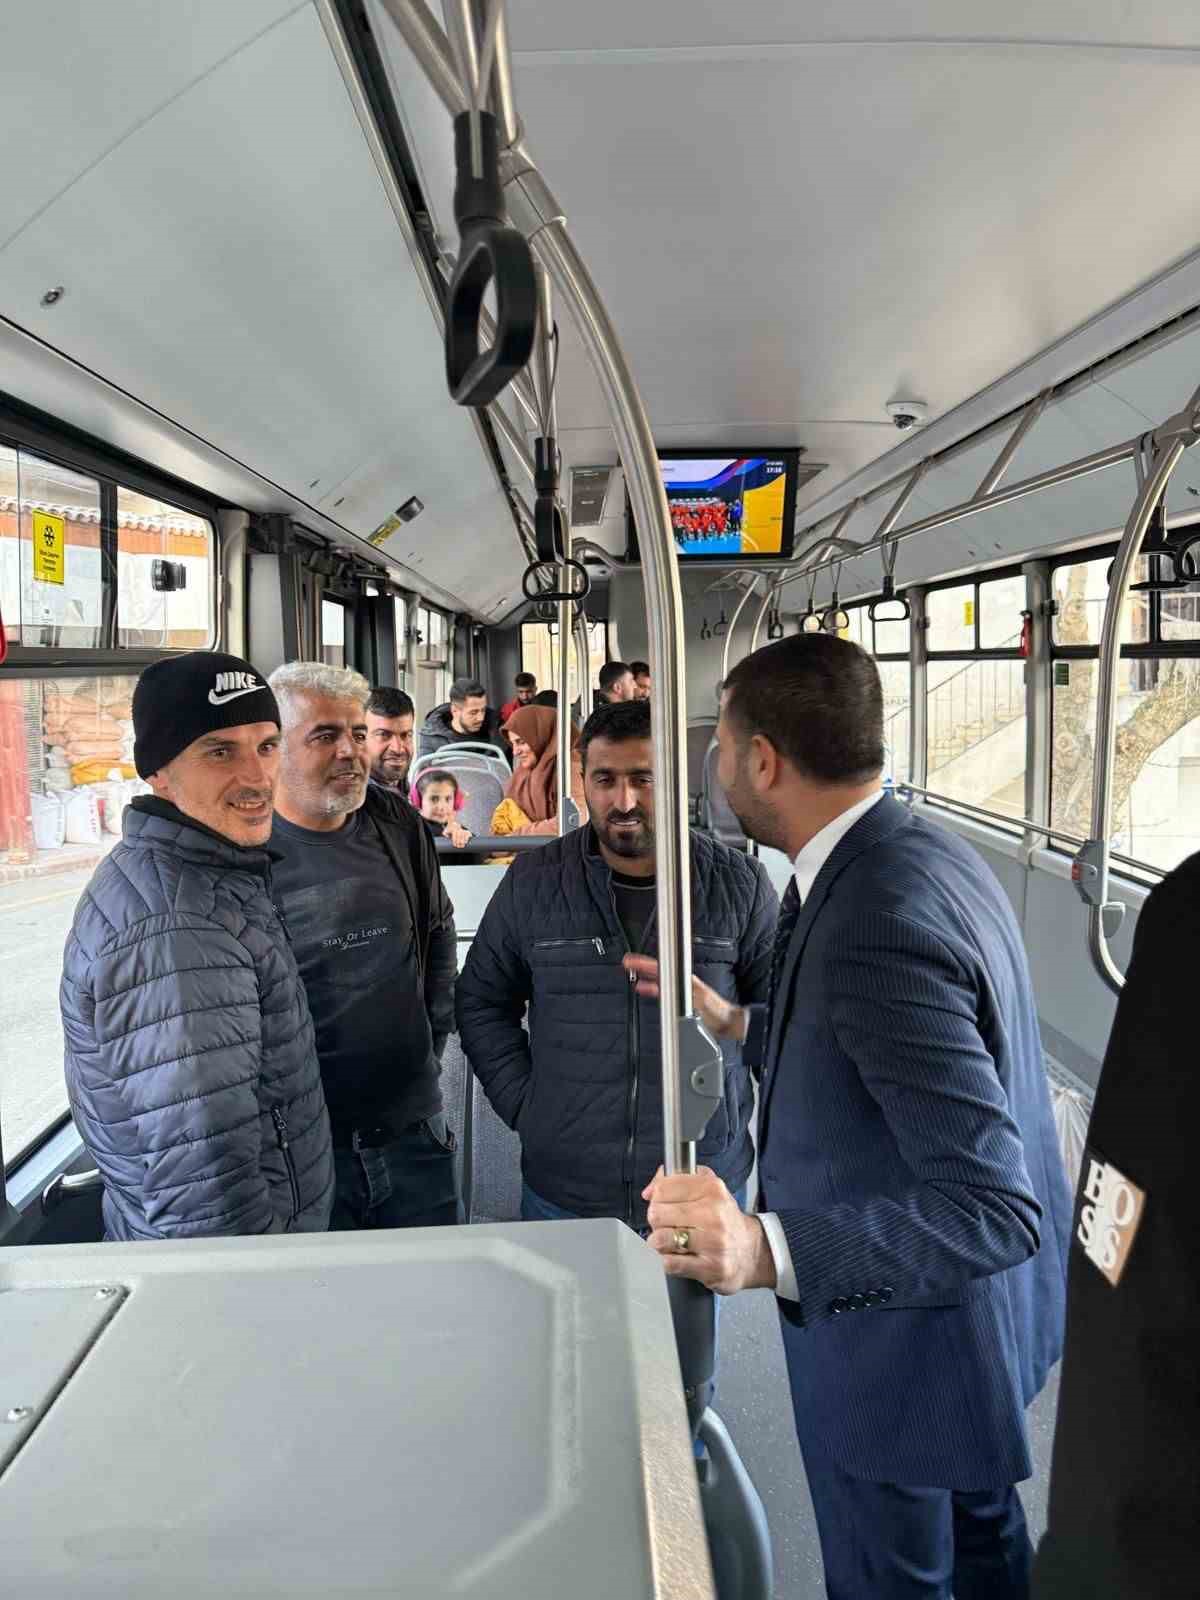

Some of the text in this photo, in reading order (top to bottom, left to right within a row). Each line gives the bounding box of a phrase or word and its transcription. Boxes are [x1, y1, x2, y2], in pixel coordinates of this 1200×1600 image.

[215, 671, 257, 692] NIKE
[322, 936, 345, 948] Stay
[361, 927, 388, 938] Leave
